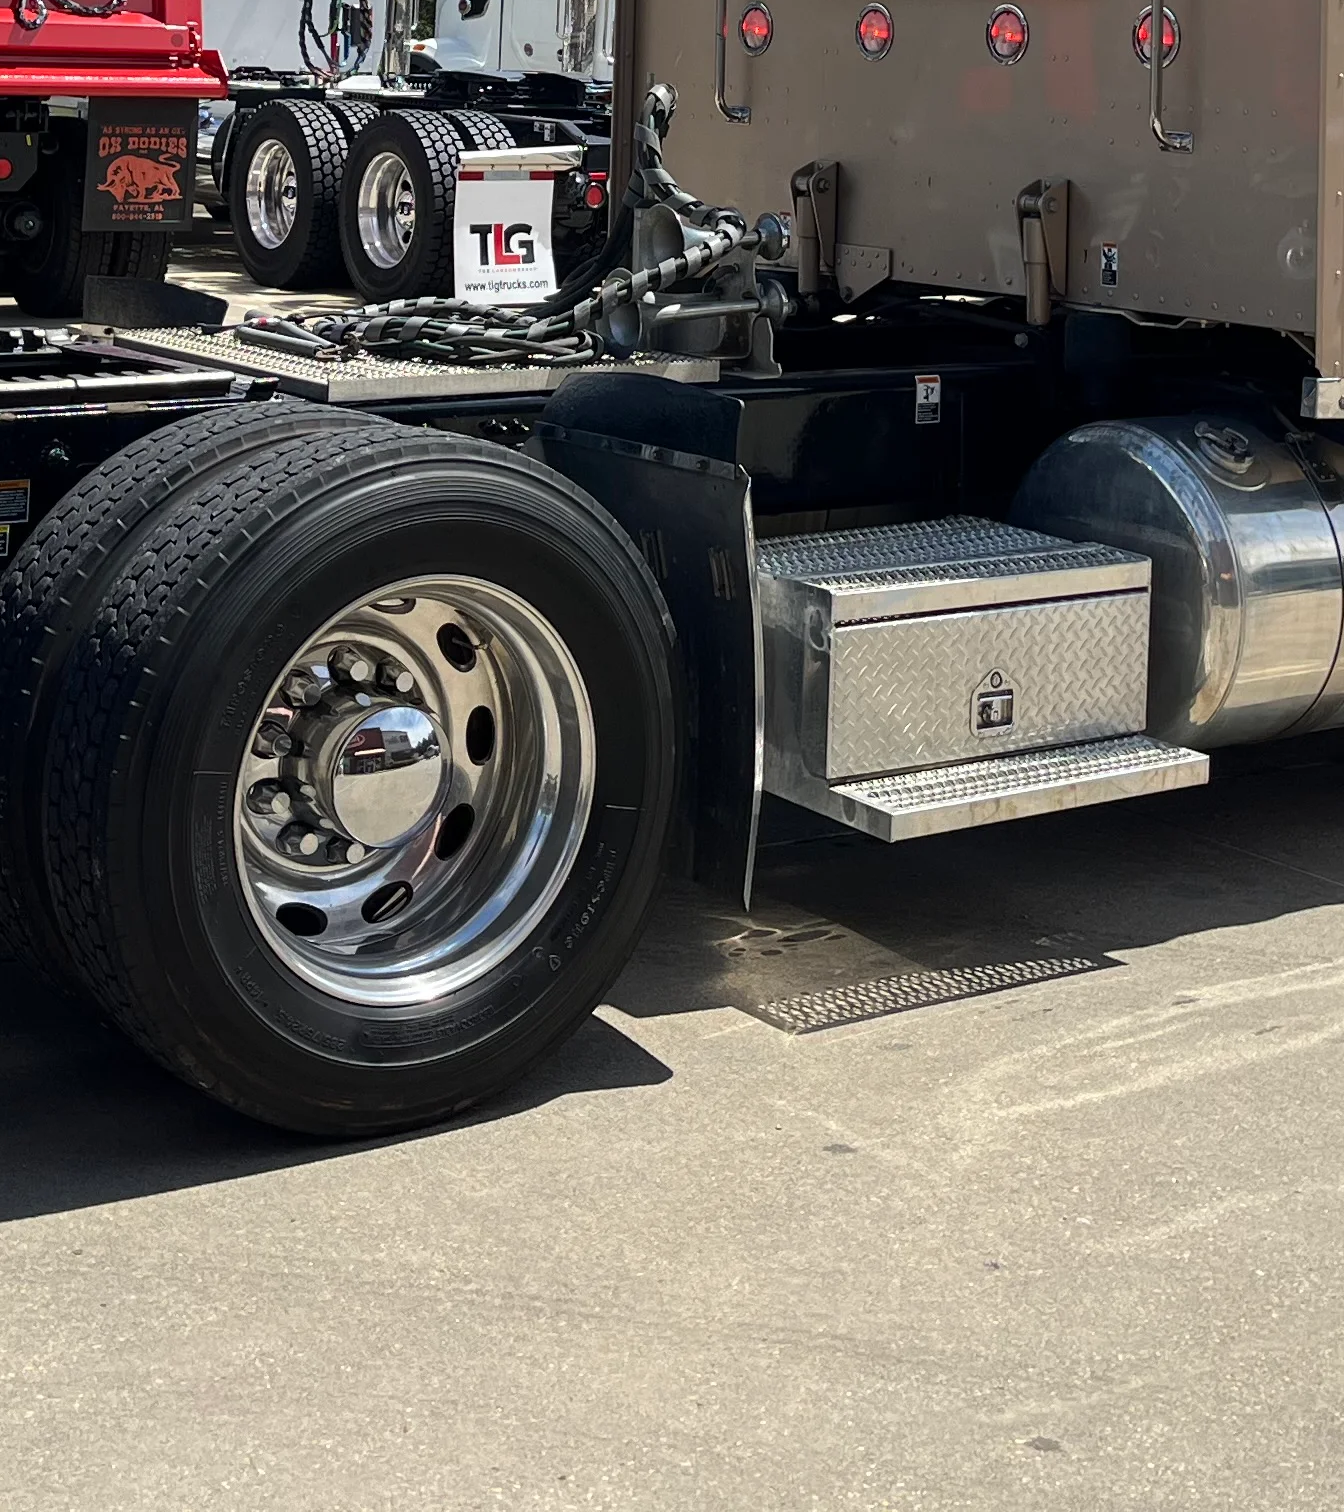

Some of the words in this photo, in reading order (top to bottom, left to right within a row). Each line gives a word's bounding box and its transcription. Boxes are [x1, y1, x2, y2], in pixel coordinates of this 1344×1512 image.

[98, 136, 122, 158] OX
[469, 223, 535, 266] TLG
[464, 279, 548, 293] www.tlgtrucks.com
